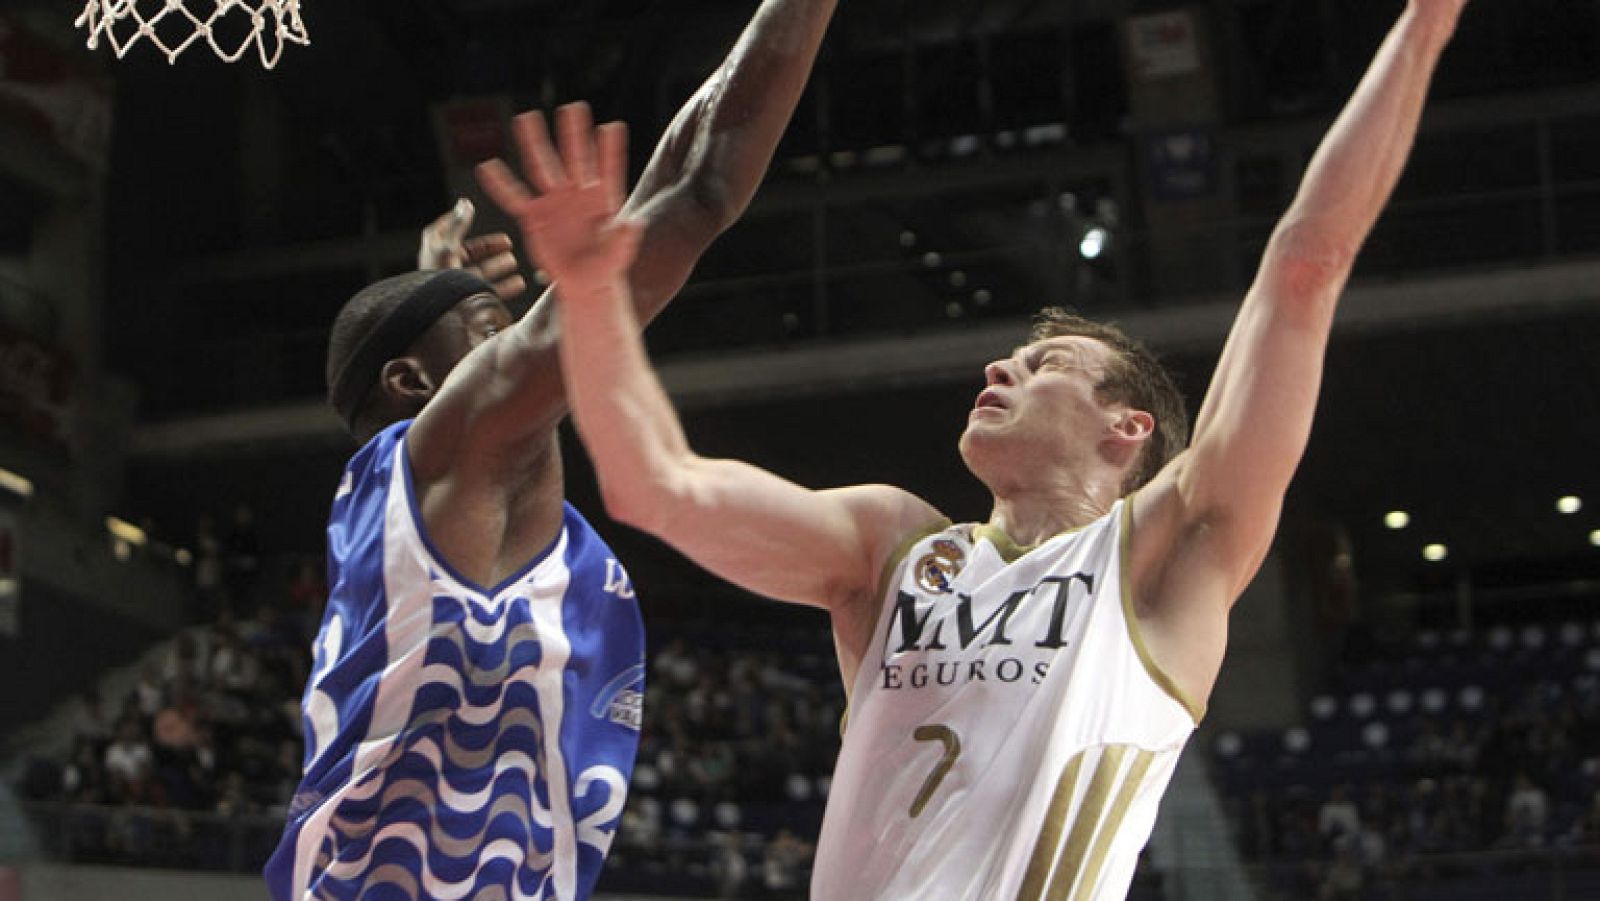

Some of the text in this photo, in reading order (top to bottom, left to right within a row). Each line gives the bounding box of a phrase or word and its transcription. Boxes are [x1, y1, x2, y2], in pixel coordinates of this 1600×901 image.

[884, 572, 1094, 654] MMT
[574, 765, 628, 860] 2
[908, 724, 961, 819] 7
